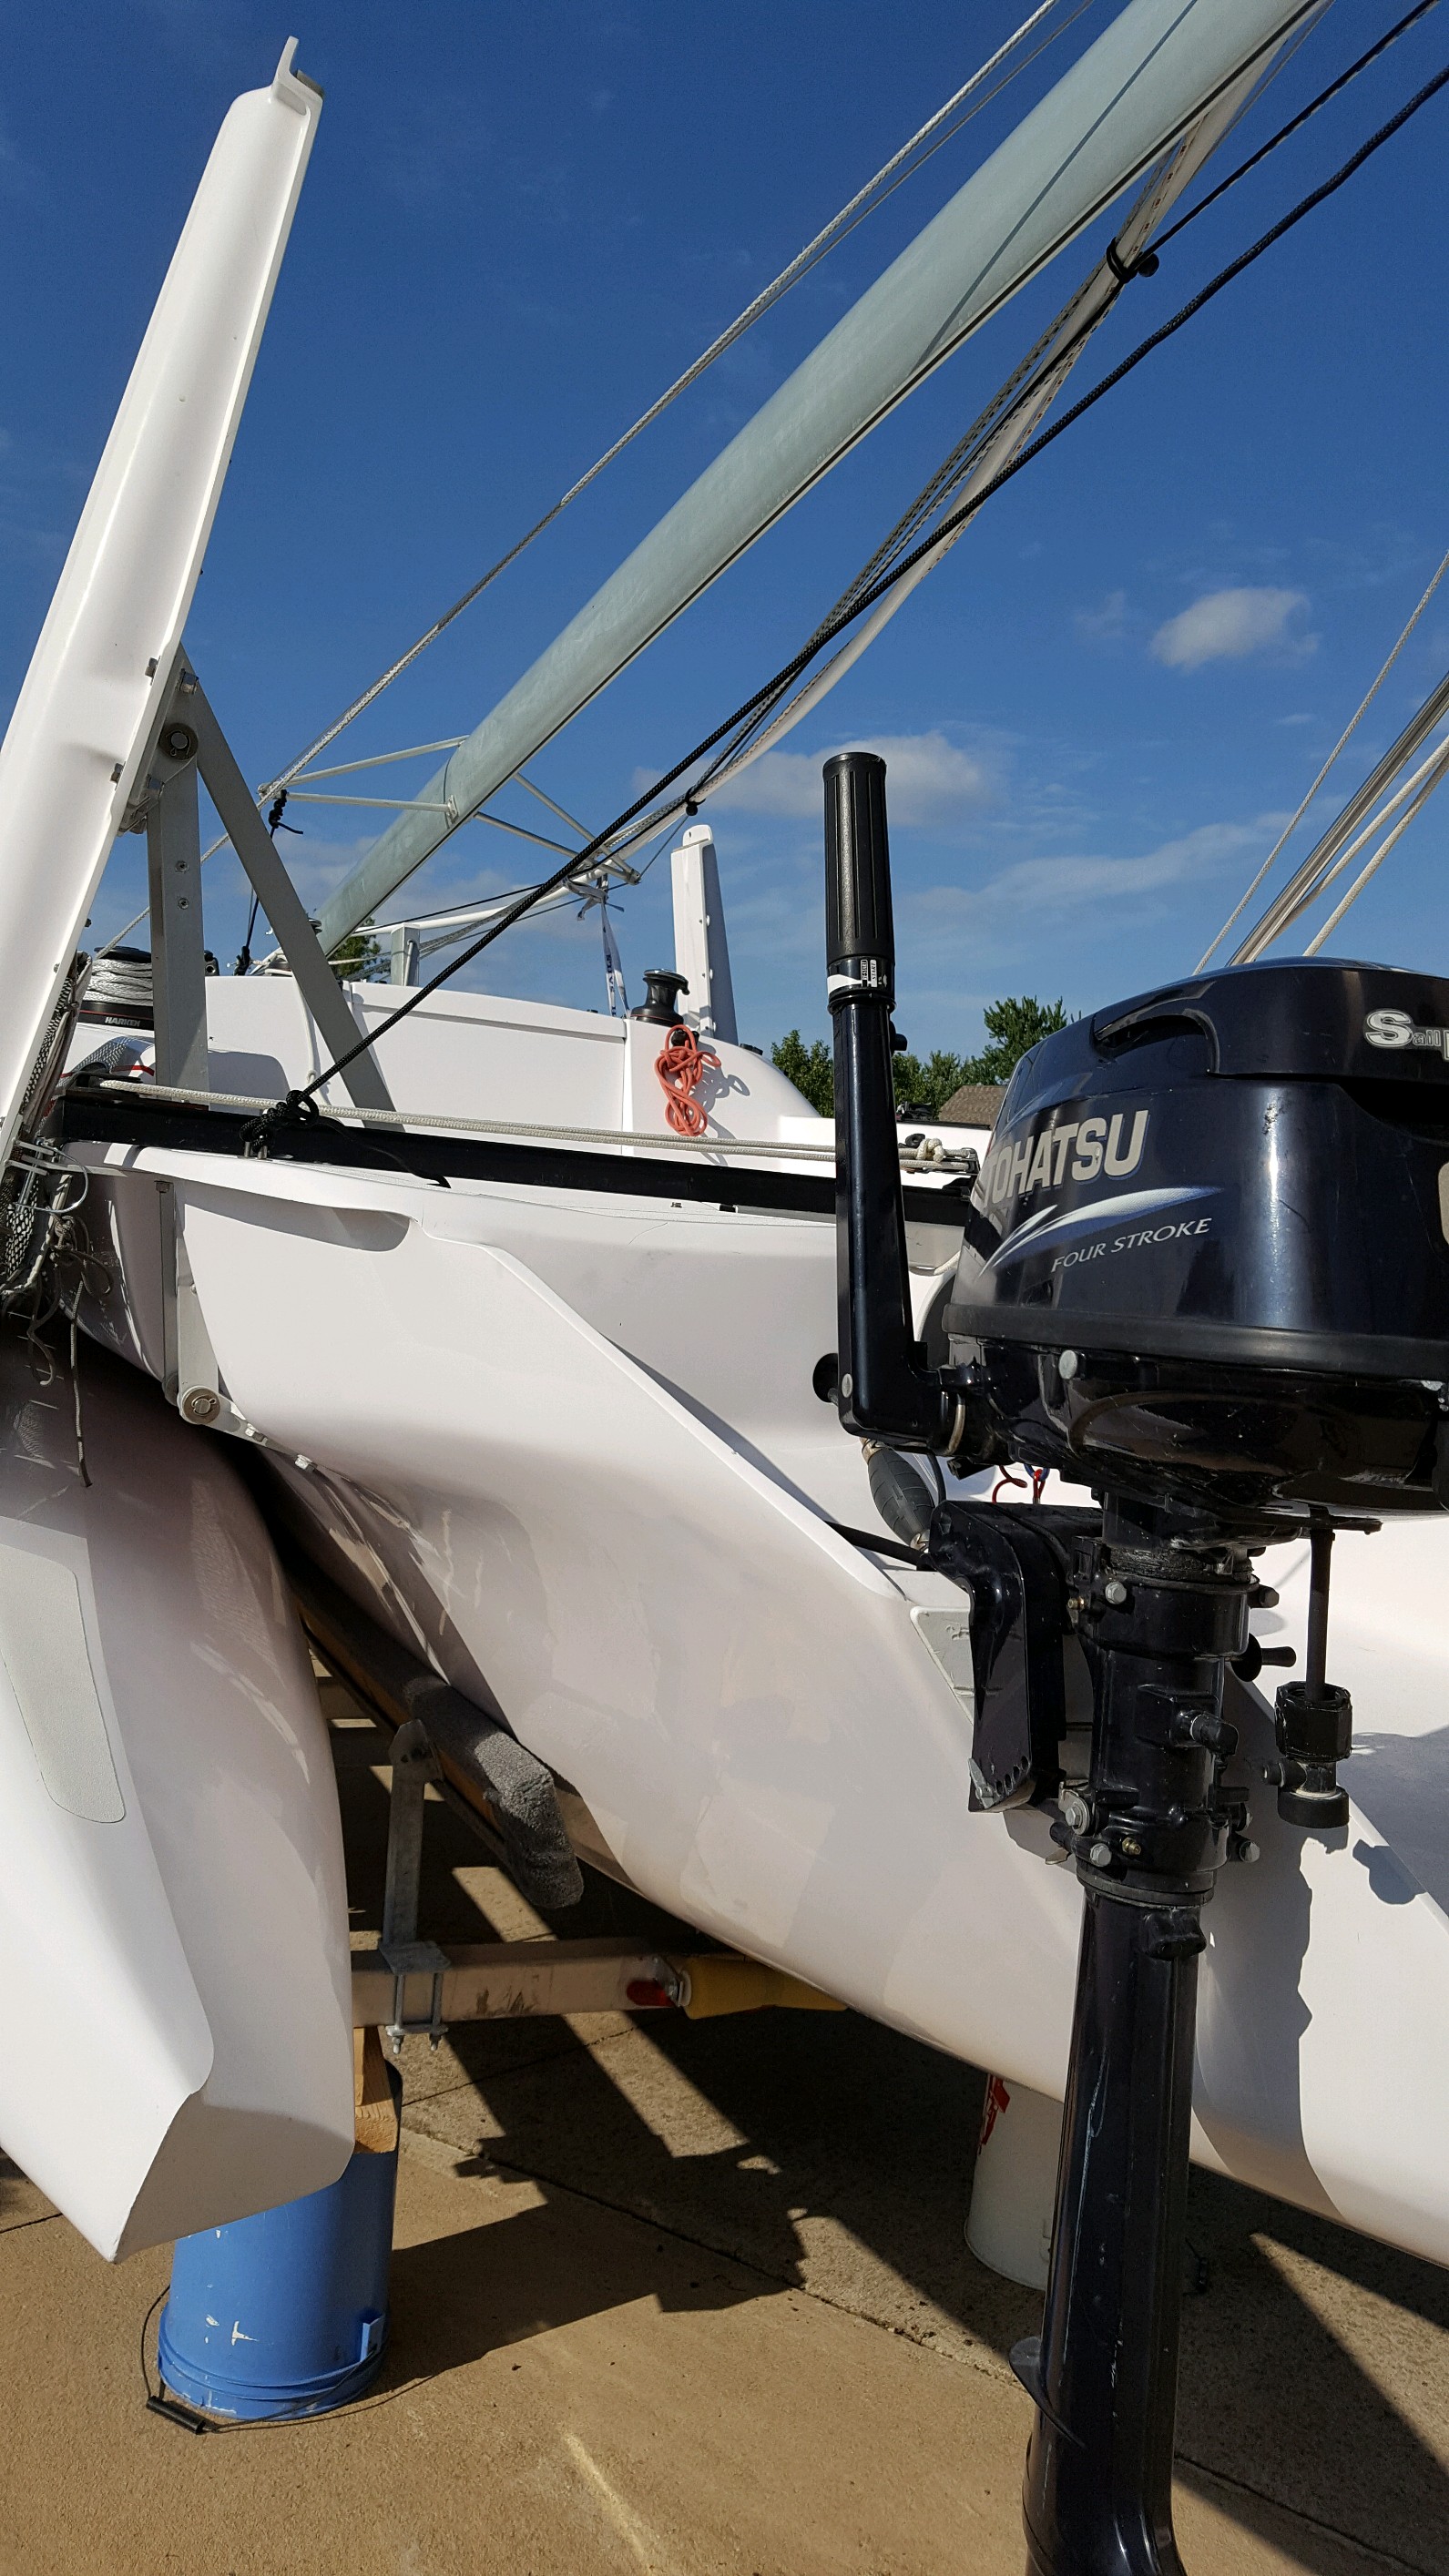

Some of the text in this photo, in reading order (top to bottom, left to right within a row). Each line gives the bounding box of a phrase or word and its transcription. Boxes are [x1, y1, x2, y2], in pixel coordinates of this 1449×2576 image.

[105, 1016, 141, 1027] HARKEN
[1366, 1010, 1449, 1061] Sail
[985, 1110, 1149, 1206] TOHATSU
[1051, 1217, 1212, 1273] FOUR STROKE
